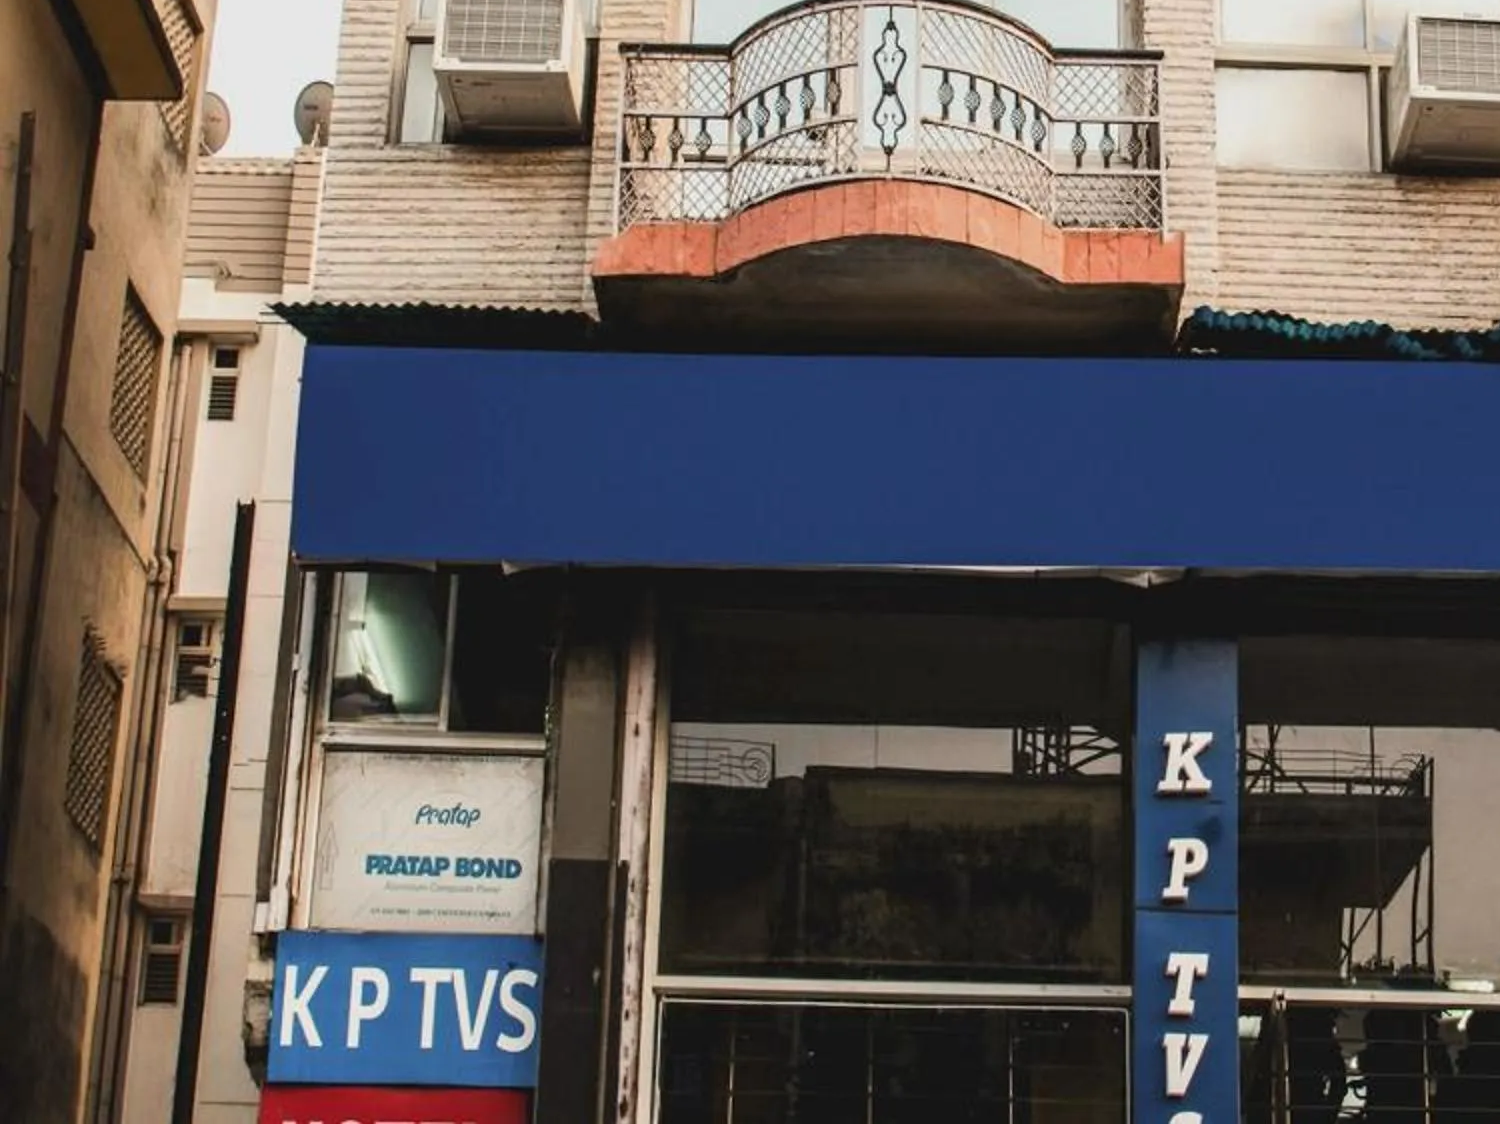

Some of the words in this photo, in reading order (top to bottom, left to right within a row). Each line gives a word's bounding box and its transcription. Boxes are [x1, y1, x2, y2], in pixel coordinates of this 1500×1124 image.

[415, 802, 481, 828] Pratap
[364, 854, 450, 877] PRATAP
[454, 857, 523, 880] BOND
[279, 965, 330, 1048] K
[345, 966, 390, 1049] P
[409, 967, 539, 1053] TVS
[1163, 952, 1209, 1124] TV
